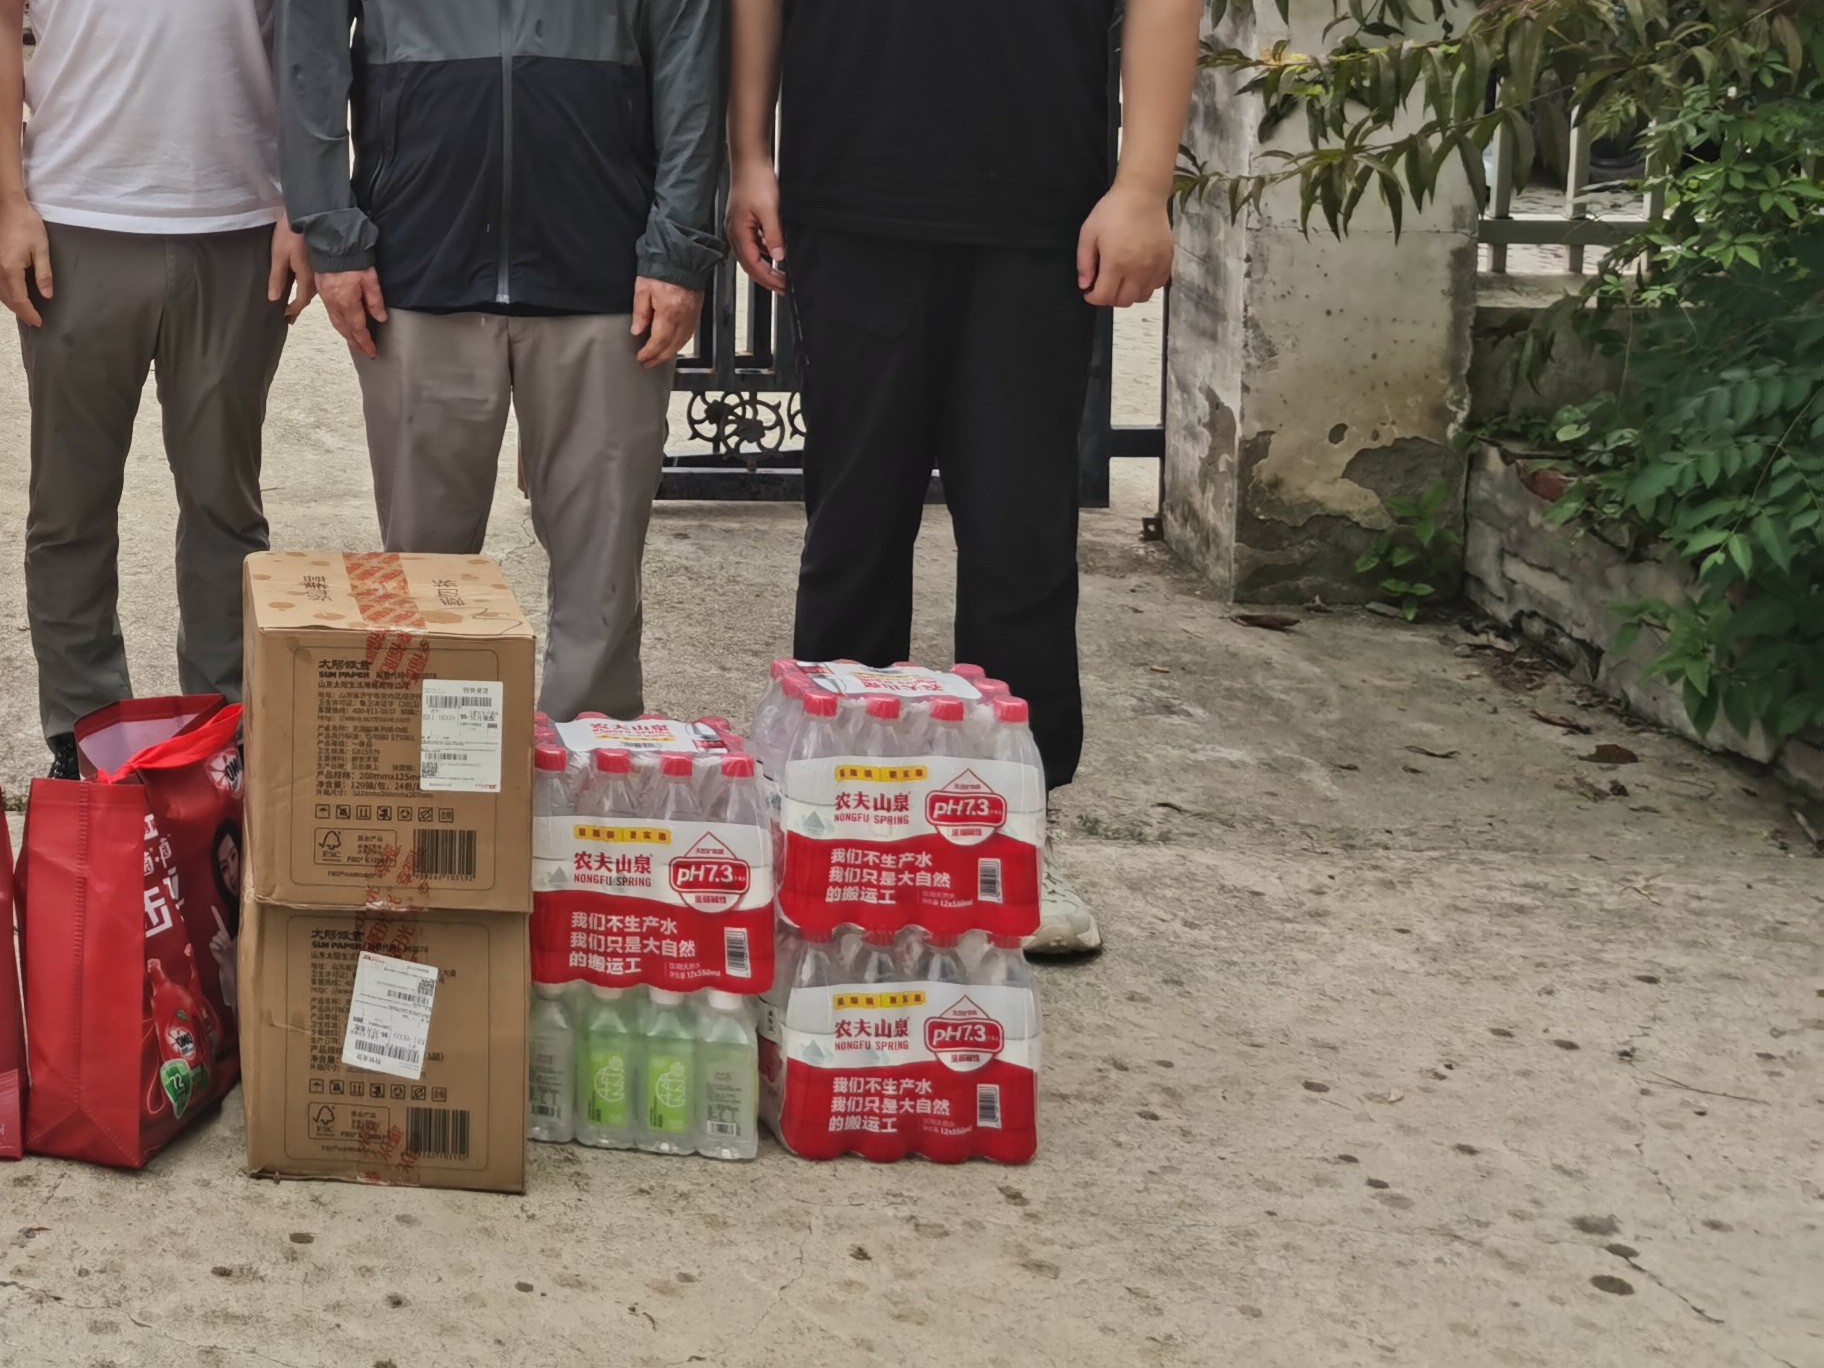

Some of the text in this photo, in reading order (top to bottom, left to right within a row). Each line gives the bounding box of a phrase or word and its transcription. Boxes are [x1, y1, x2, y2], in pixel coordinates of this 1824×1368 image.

[319, 671, 336, 679] SUN
[834, 791, 909, 813] 农夫山泉
[933, 799, 990, 819] pH7.3
[834, 813, 909, 825] NONGFU SPRING
[574, 851, 651, 874] 农夫山泉
[830, 847, 933, 869] 我们不生产水
[574, 873, 651, 887] NONGFU SPRING
[676, 864, 734, 886] pH7.3
[828, 866, 951, 888] 我们只是大自然
[825, 885, 897, 905] 的搬运工
[571, 912, 678, 935] 我们不生产水
[569, 931, 696, 958] 我们只是大自然
[568, 951, 642, 975] 的搬运工
[834, 1017, 909, 1038] 农夫山泉
[933, 1024, 986, 1045] pH7.3
[835, 1040, 909, 1051] NONGFU SPRING
[833, 1076, 932, 1095] 我们不生产水
[831, 1096, 950, 1116] 我们只是大自然
[828, 1115, 898, 1133] 的搬运工
